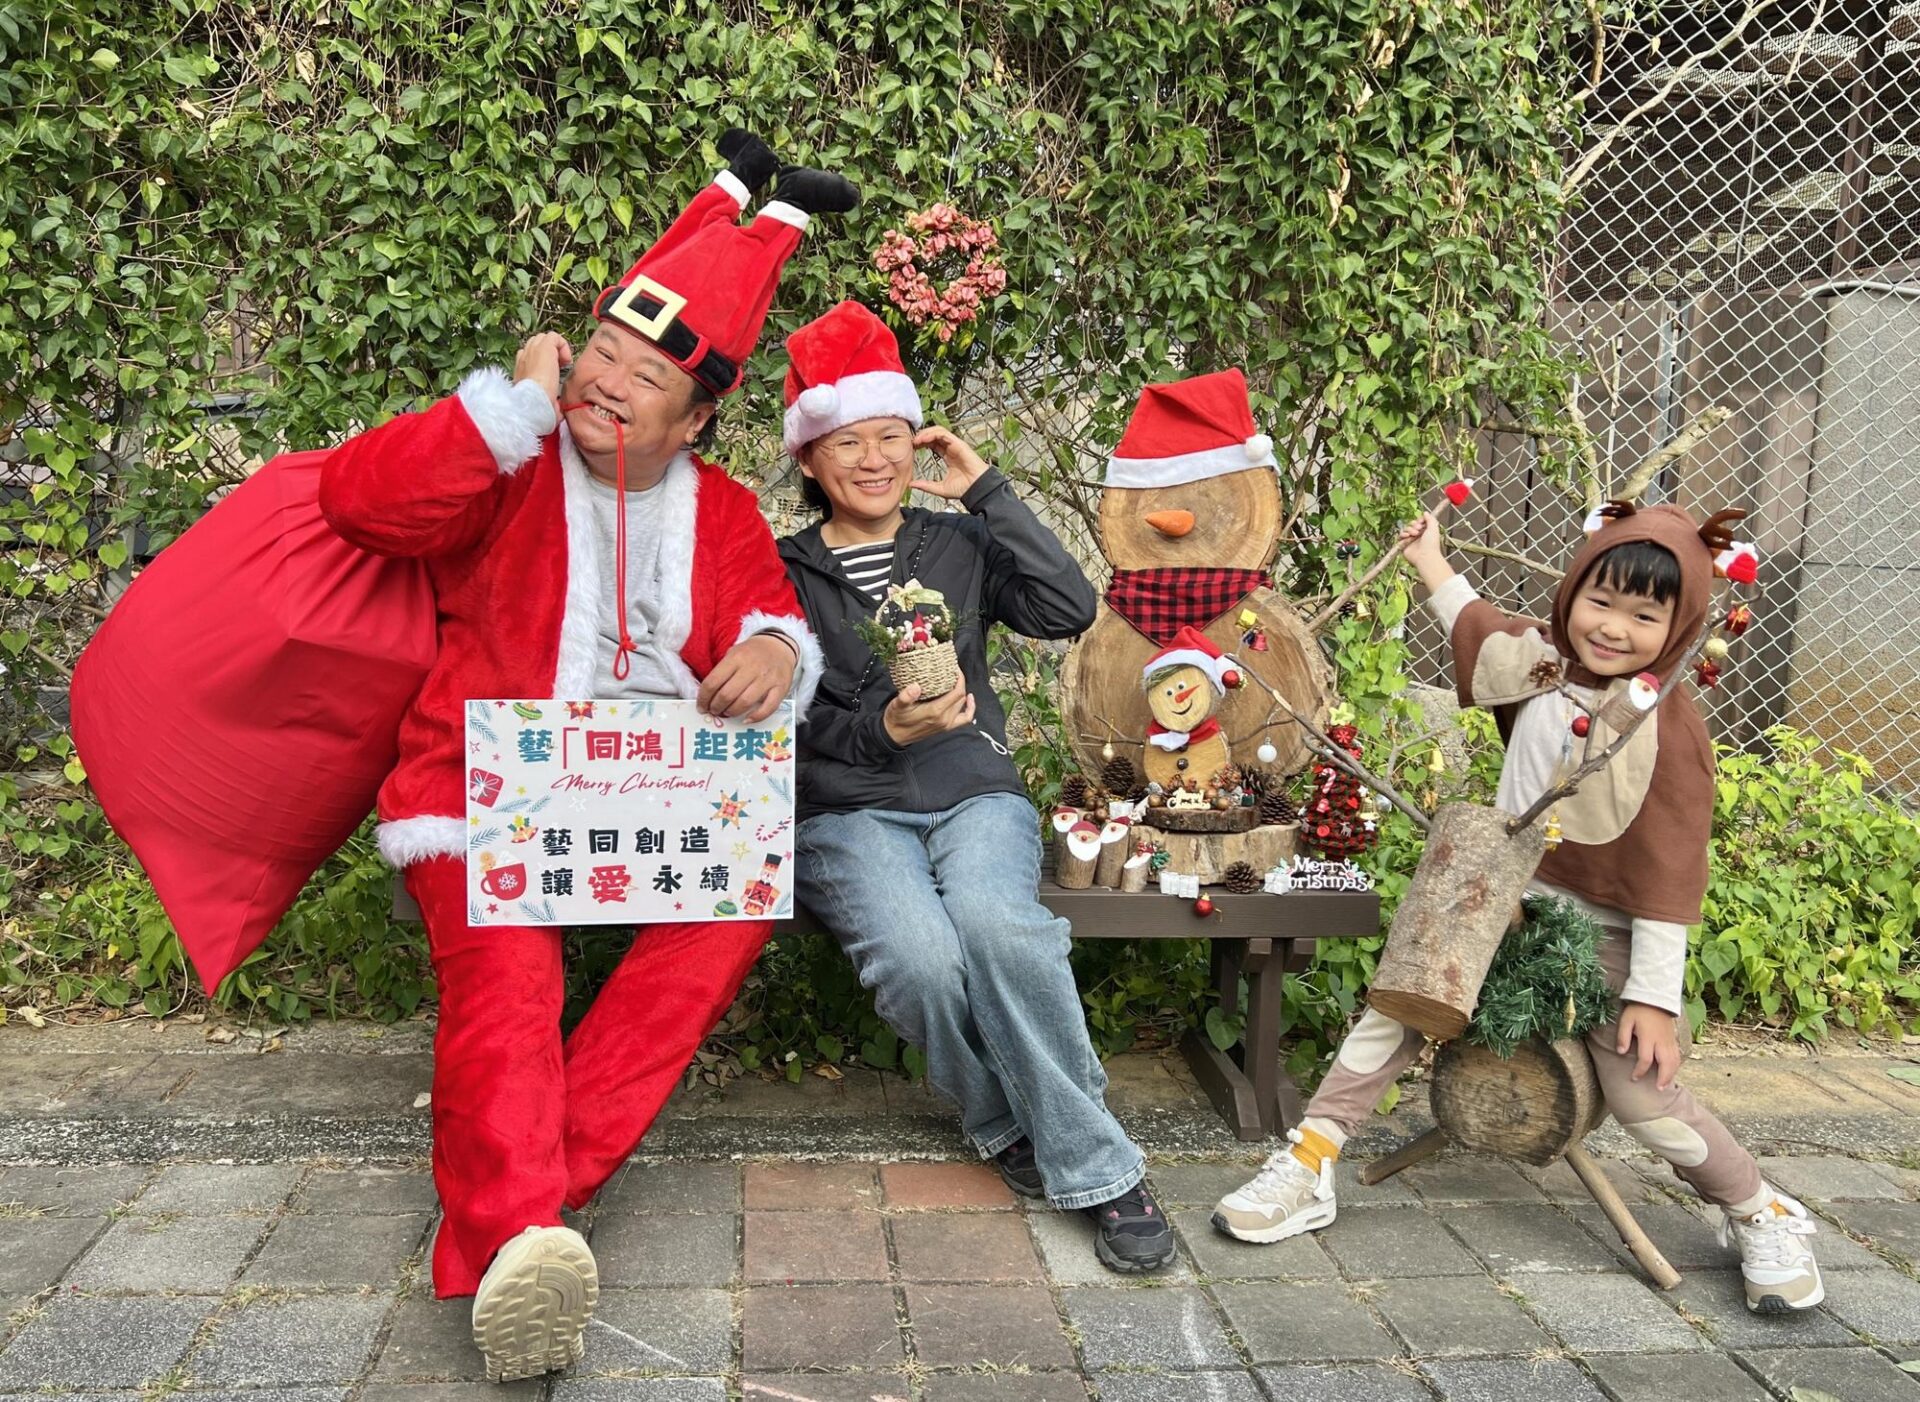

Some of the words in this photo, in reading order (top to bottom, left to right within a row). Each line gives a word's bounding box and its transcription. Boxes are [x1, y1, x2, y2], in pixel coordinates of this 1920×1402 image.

[551, 774, 616, 796] Merry
[619, 771, 713, 795] Christmas!
[542, 826, 710, 856] 藝同創造
[1291, 854, 1351, 876] Merry
[541, 864, 730, 904] 讓愛永續
[1289, 873, 1369, 892] hristmas
